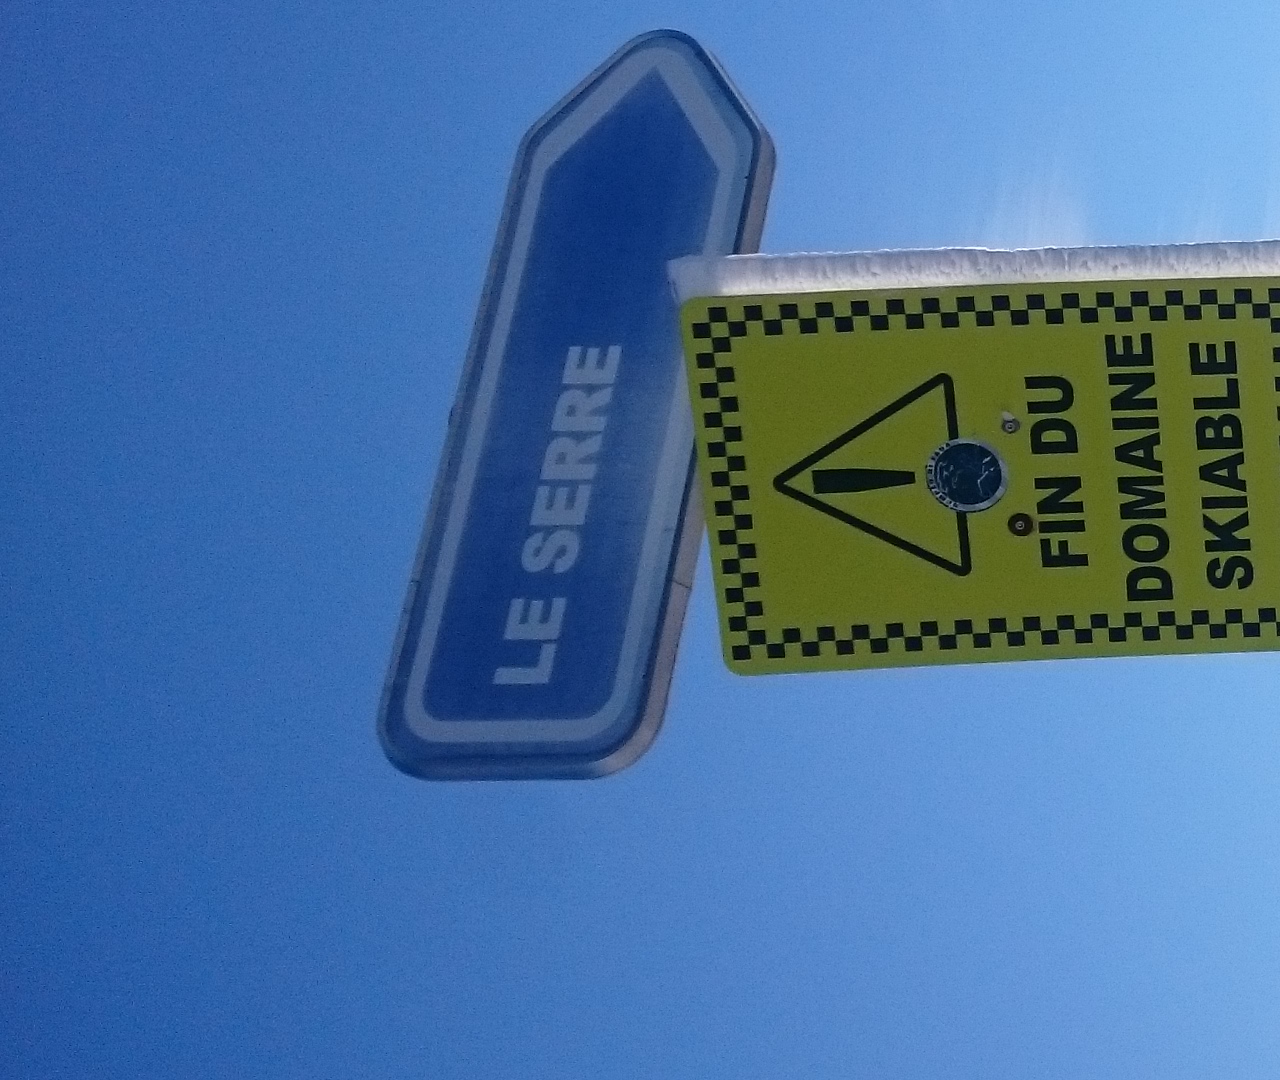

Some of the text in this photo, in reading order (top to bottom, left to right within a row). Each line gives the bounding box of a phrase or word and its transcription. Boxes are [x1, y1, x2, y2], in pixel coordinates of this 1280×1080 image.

[492, 344, 623, 685] LE SERRE
[1023, 375, 1090, 568] FIN DU
[1104, 332, 1174, 602] DOMAINE
[1188, 340, 1255, 590] SKIABLE
